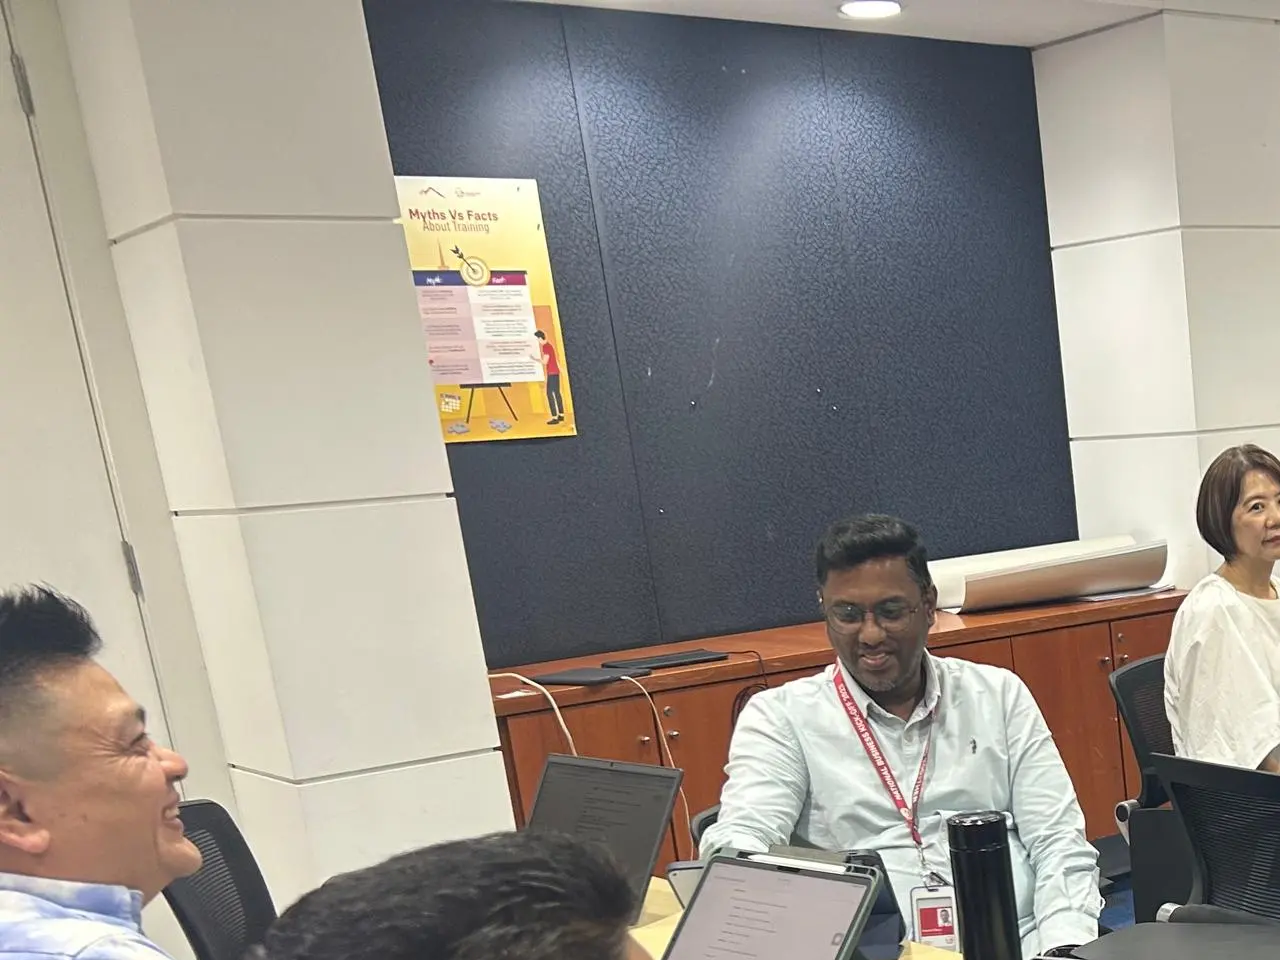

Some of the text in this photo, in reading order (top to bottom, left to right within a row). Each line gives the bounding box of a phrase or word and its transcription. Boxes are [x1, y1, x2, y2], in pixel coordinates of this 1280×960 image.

[408, 208, 499, 223] Myths Vs Facts
[423, 221, 490, 234] About Training
[845, 701, 867, 733] KICK-OFF
[862, 732, 885, 767] BUSINESS
[880, 766, 903, 801] NATIONAL
